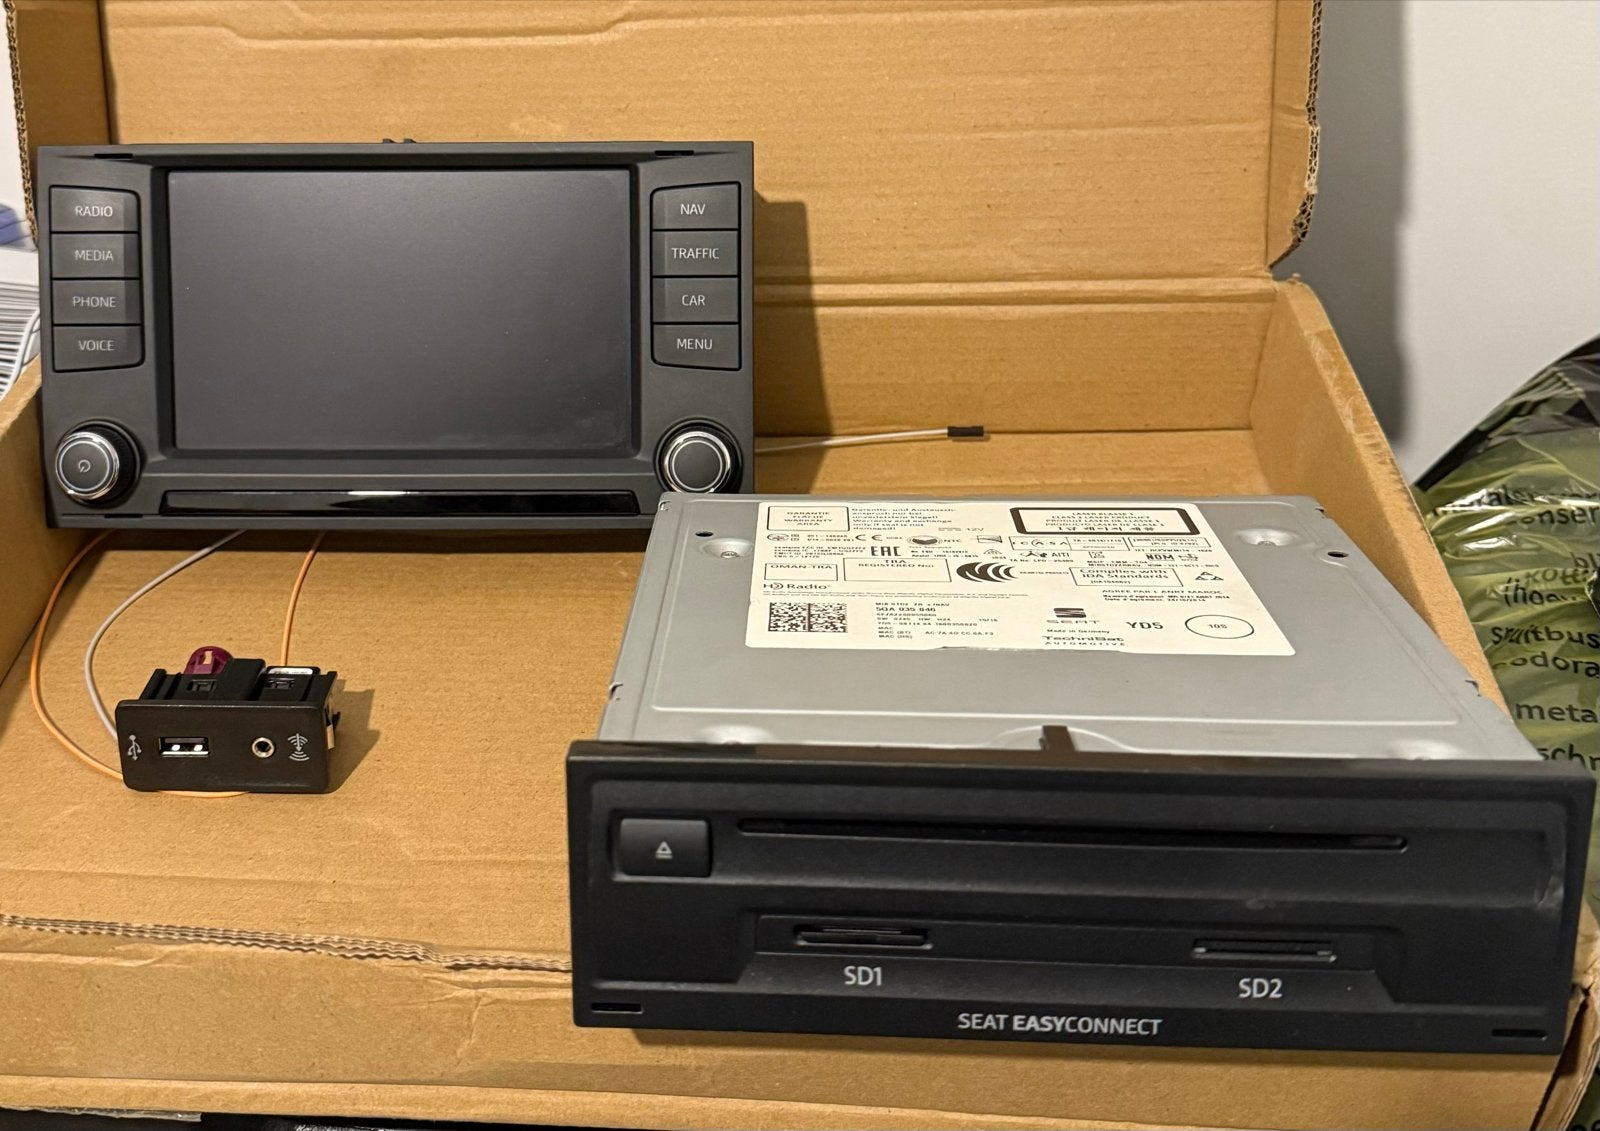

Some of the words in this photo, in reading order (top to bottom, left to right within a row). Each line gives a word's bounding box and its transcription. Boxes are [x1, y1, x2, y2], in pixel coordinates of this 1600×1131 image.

[75, 205, 113, 217] RADIO
[680, 203, 706, 215] NAV
[75, 249, 114, 261] MEDIA
[671, 247, 720, 259] TRAFFIC
[72, 296, 116, 308] PHONE
[681, 294, 706, 306] CAR
[78, 339, 115, 351] VOICE
[676, 338, 713, 350] MENU
[871, 546, 902, 556] EAC
[844, 965, 883, 986] SD1
[1238, 977, 1283, 999] SD2
[958, 1012, 1009, 1031] SEAT
[1012, 1014, 1163, 1036] EASYCONNECT
